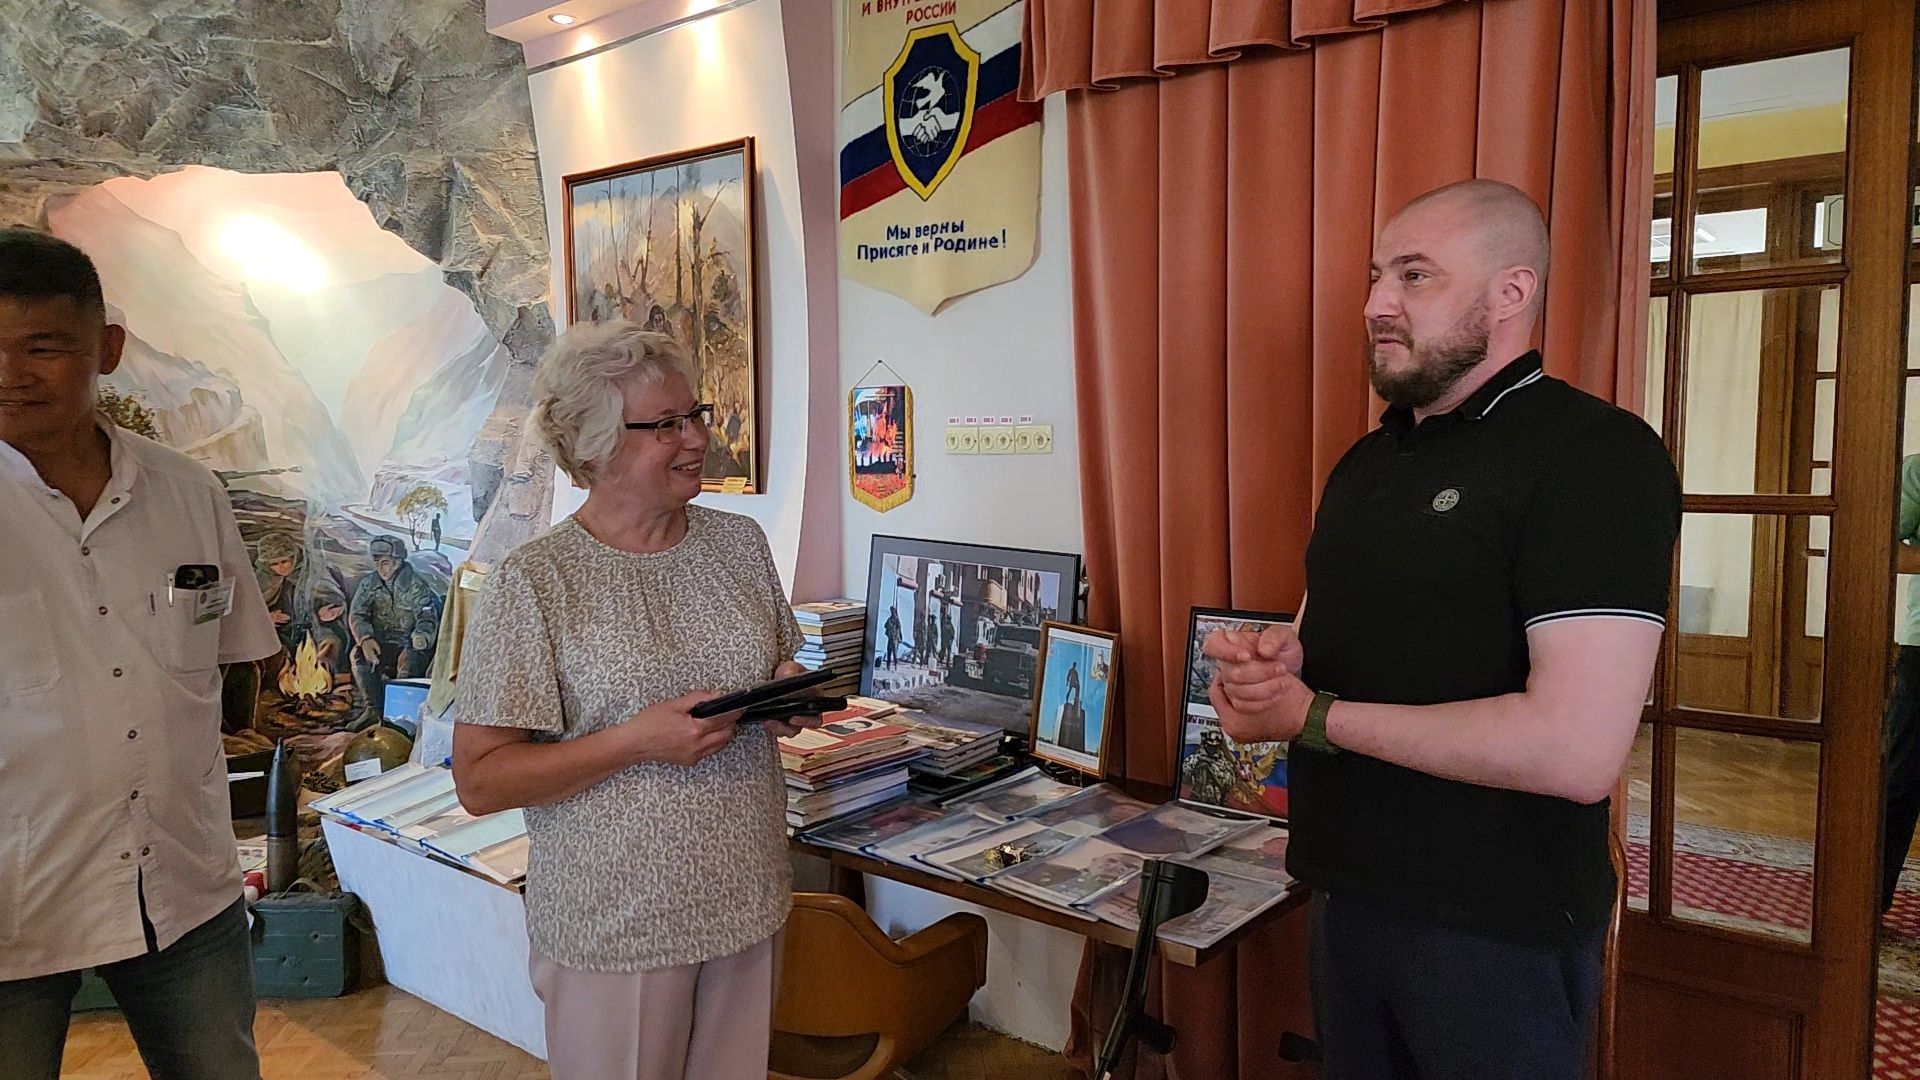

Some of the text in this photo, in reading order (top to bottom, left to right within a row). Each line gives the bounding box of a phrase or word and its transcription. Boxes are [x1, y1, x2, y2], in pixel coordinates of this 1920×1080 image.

[861, 2, 871, 17] И
[906, 1, 957, 24] РОССИИ
[886, 220, 964, 241] Мы верны
[857, 244, 918, 263] Присяге
[921, 242, 929, 254] и
